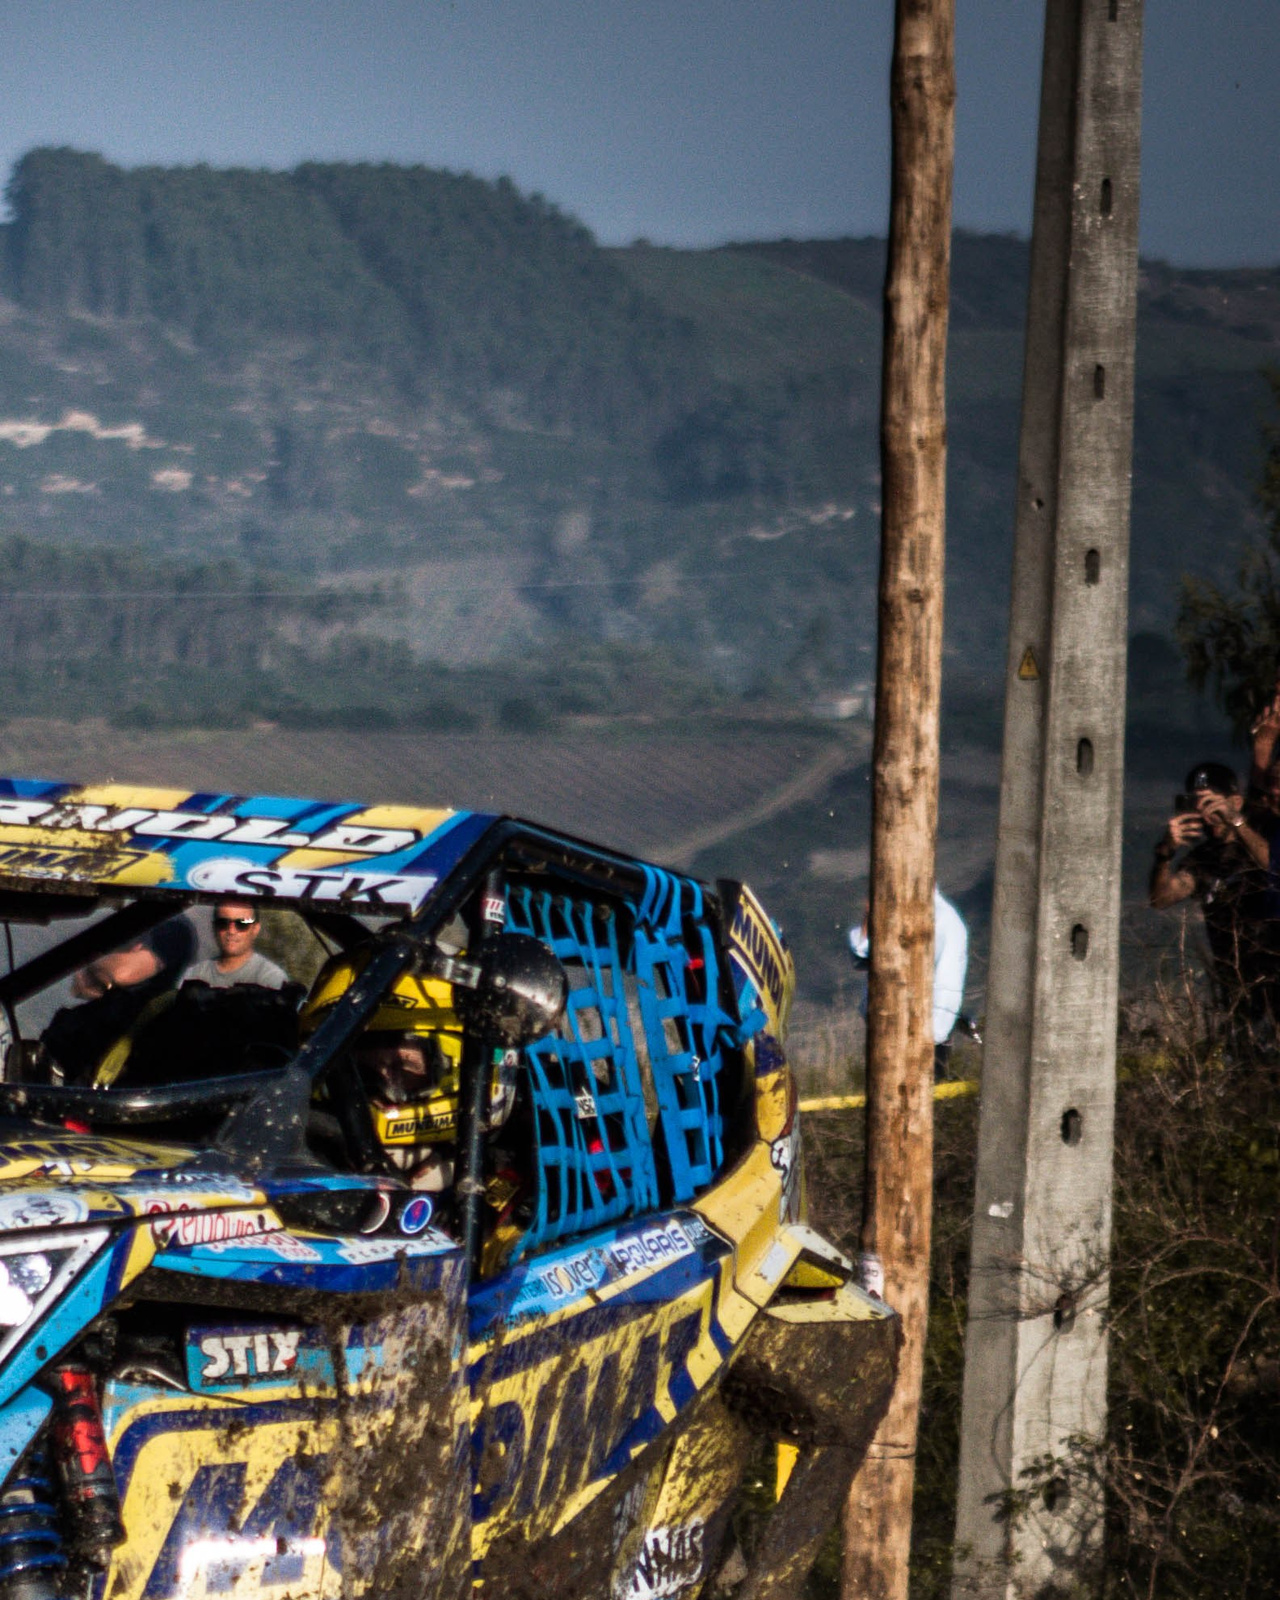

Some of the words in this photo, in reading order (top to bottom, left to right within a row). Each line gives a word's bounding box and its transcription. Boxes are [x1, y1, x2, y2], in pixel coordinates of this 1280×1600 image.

[235, 871, 406, 903] STK
[617, 1228, 689, 1269] POLARIS
[200, 1332, 301, 1379] STIX
